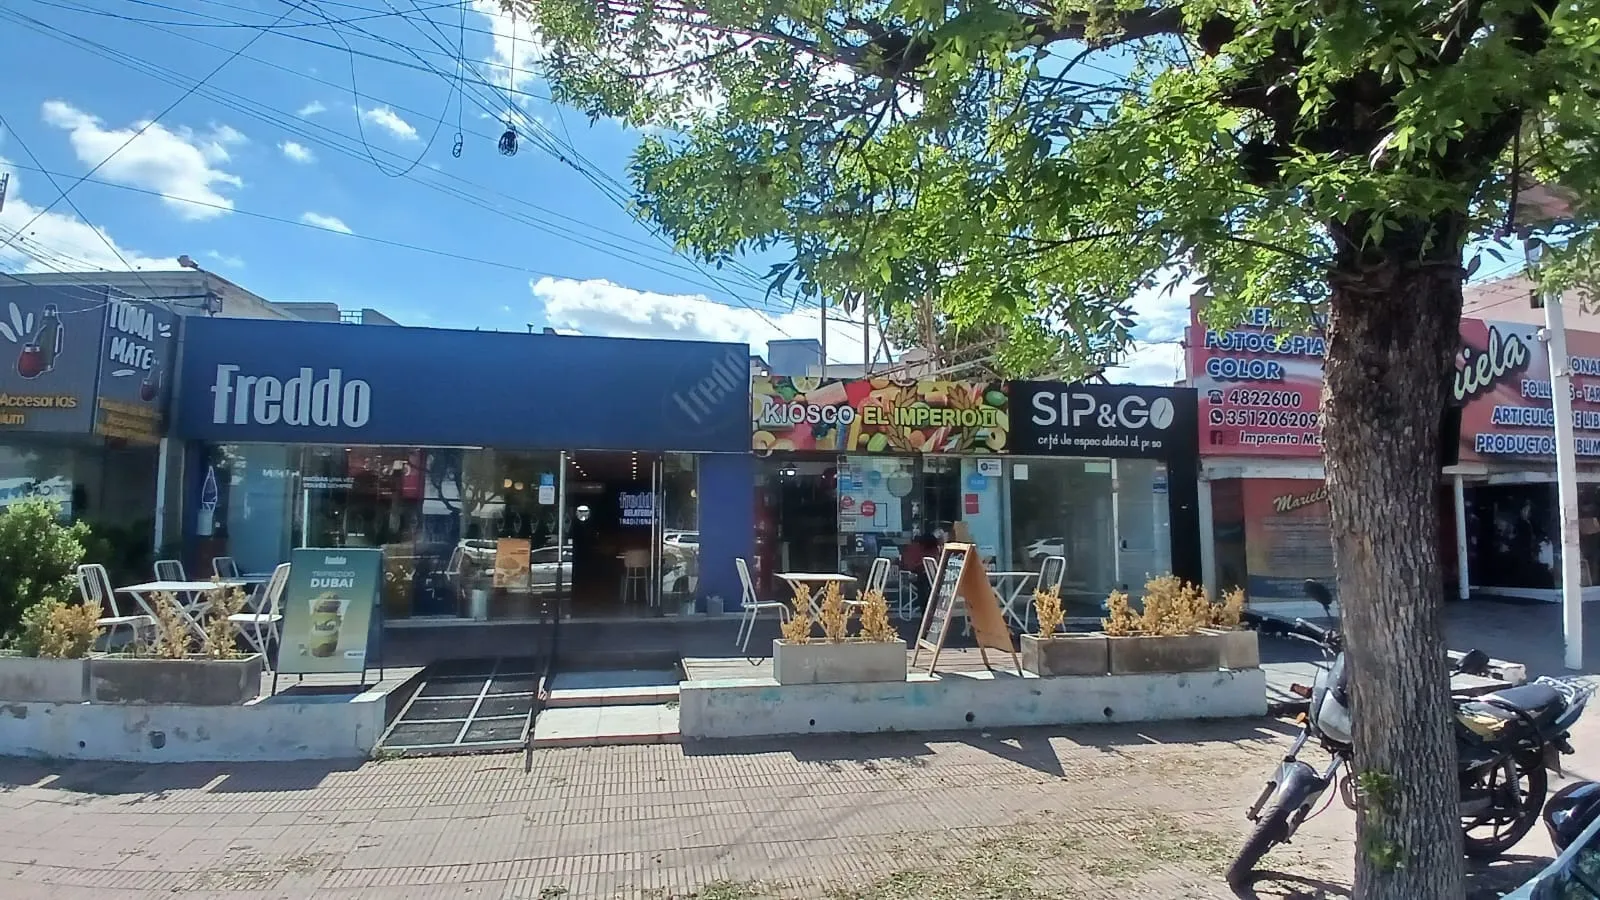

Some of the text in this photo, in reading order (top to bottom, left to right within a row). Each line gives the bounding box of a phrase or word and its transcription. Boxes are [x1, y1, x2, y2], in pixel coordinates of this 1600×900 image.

[110, 300, 154, 341] TOMA
[110, 336, 154, 370] MATE
[1206, 358, 1280, 379] COLOR
[0, 392, 77, 408] Accesorios
[211, 364, 371, 428] freddo
[1229, 389, 1301, 408] 4822600
[765, 403, 854, 426] KIOSCO
[864, 406, 889, 425] EL
[895, 407, 977, 427] IMPERIO
[1032, 391, 1174, 429] SIP&GO
[1226, 410, 1318, 428] 351206209
[1060, 432, 1072, 445] de
[1130, 435, 1139, 447] al
[1240, 430, 1298, 447] Imprenta
[310, 578, 354, 588] DUBAI
